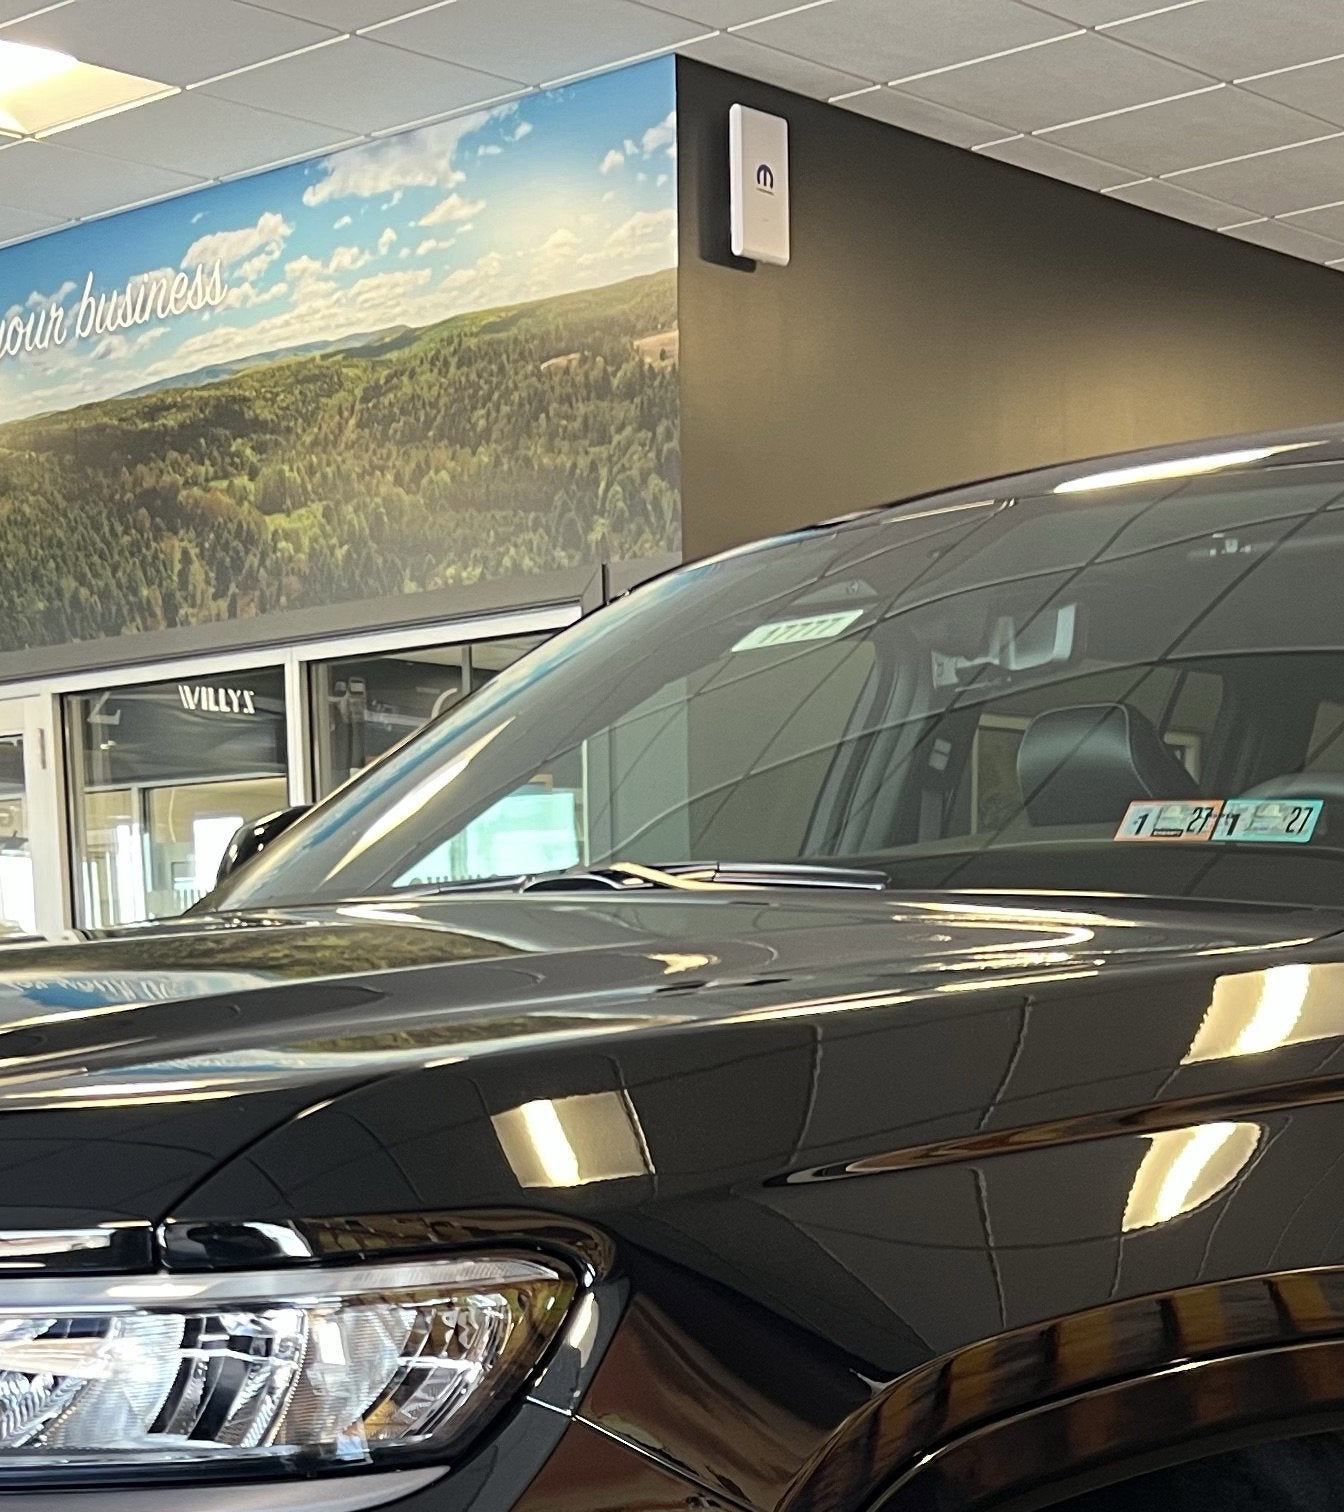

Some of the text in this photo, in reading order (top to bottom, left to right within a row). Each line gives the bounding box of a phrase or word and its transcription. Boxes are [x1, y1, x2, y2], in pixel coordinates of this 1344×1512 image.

[74, 258, 229, 338] business
[178, 684, 255, 714] WILLYS
[1135, 806, 1216, 836] 1 27
[1227, 806, 1314, 836] 1 27
